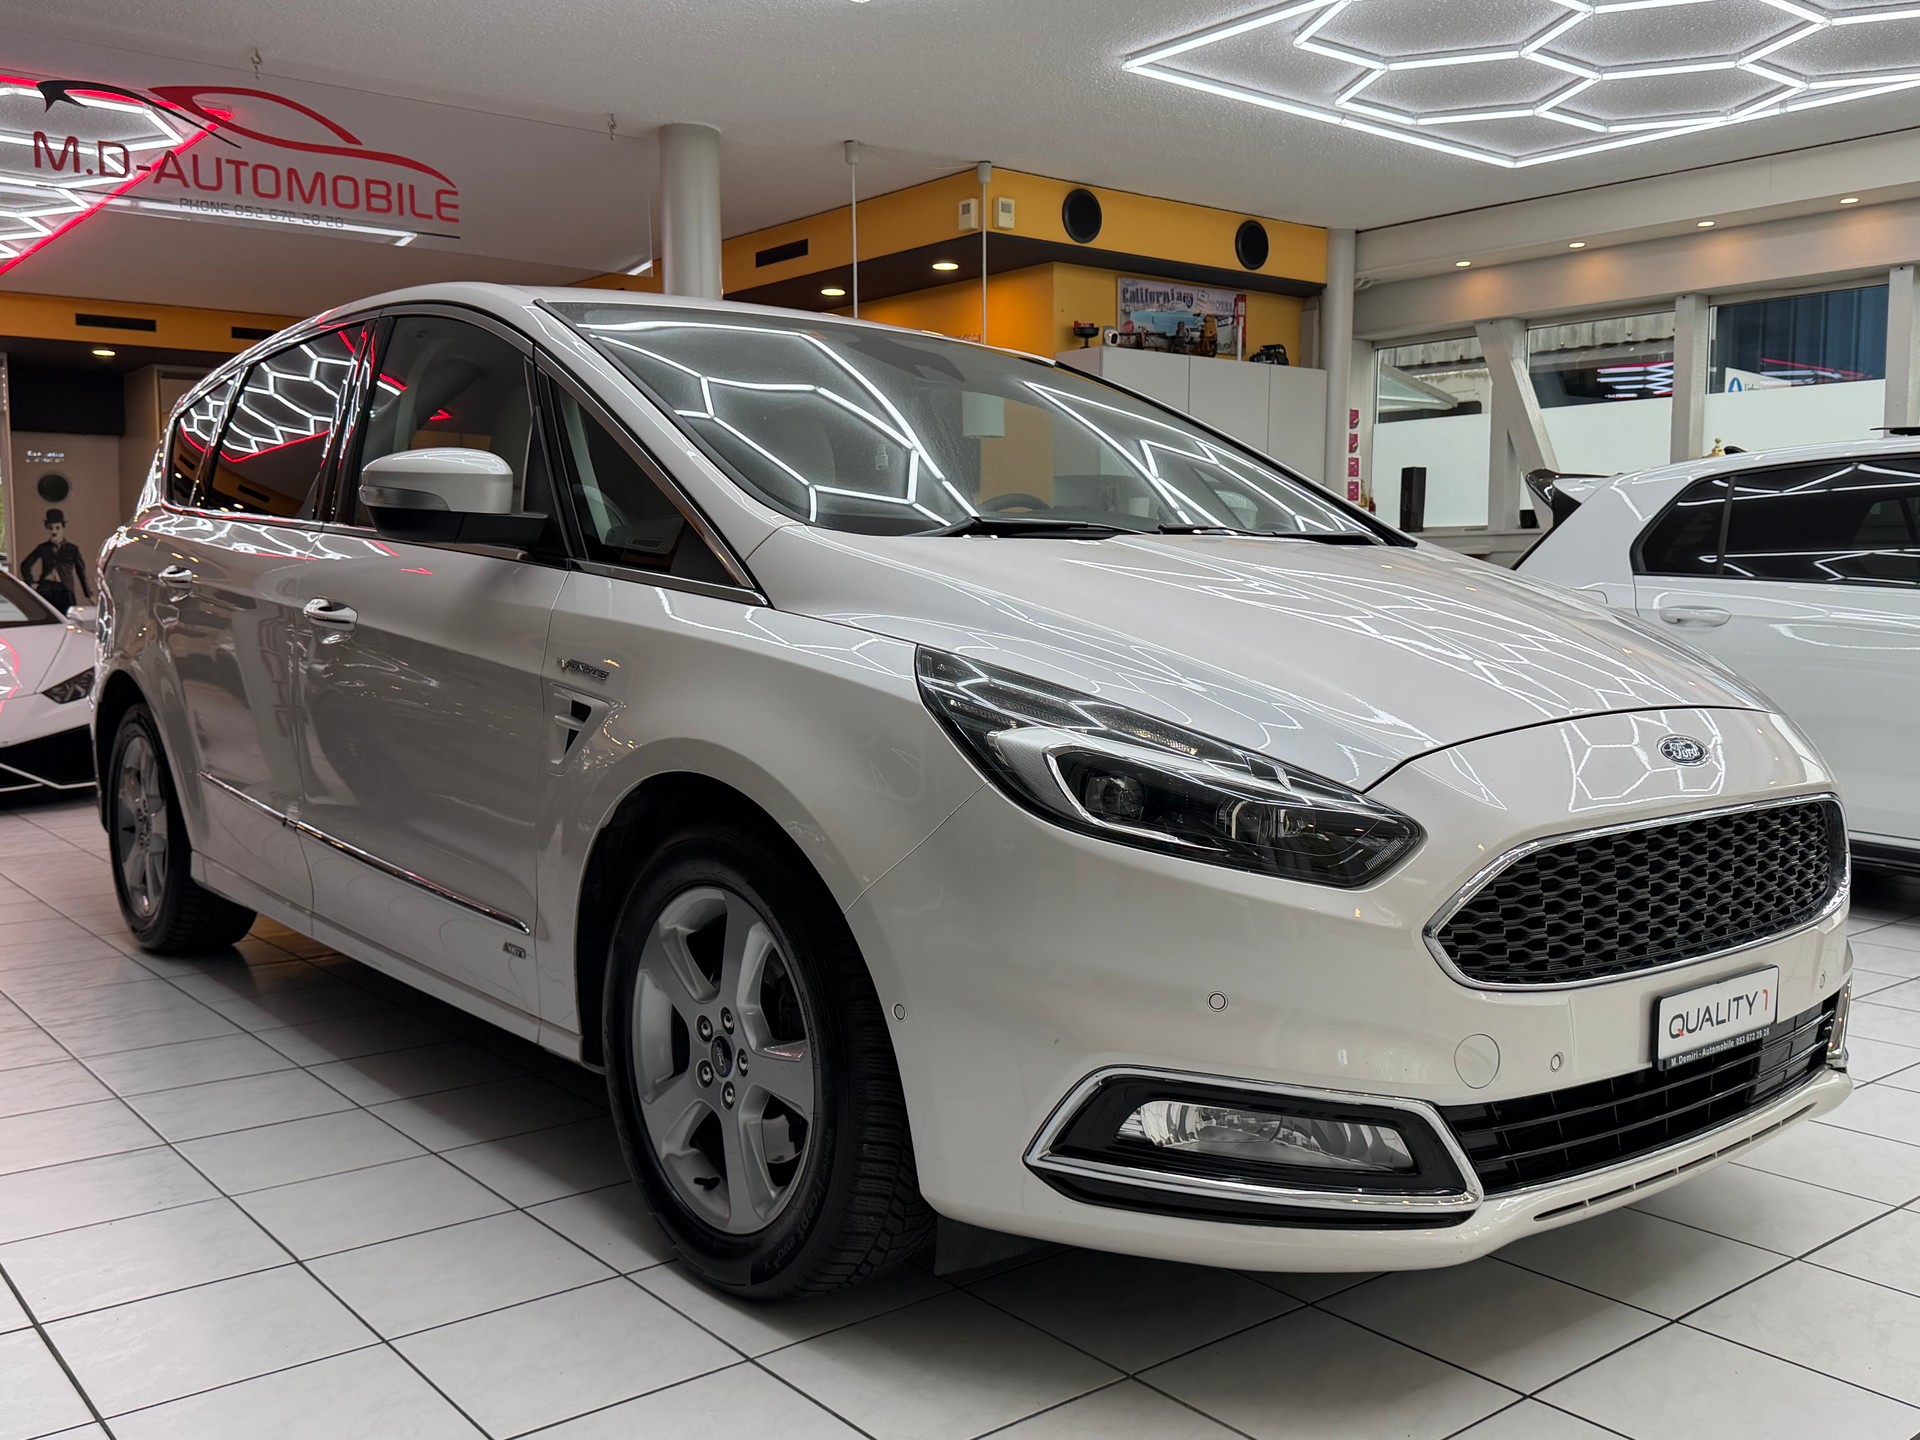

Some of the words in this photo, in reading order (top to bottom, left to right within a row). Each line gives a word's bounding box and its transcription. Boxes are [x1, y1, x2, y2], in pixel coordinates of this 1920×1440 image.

[179, 197, 229, 215] PHONE
[1122, 287, 1182, 304] California
[1669, 740, 1700, 759] Ford
[1668, 991, 1758, 1039] QUALITY
[1735, 1035, 1746, 1046] 052
